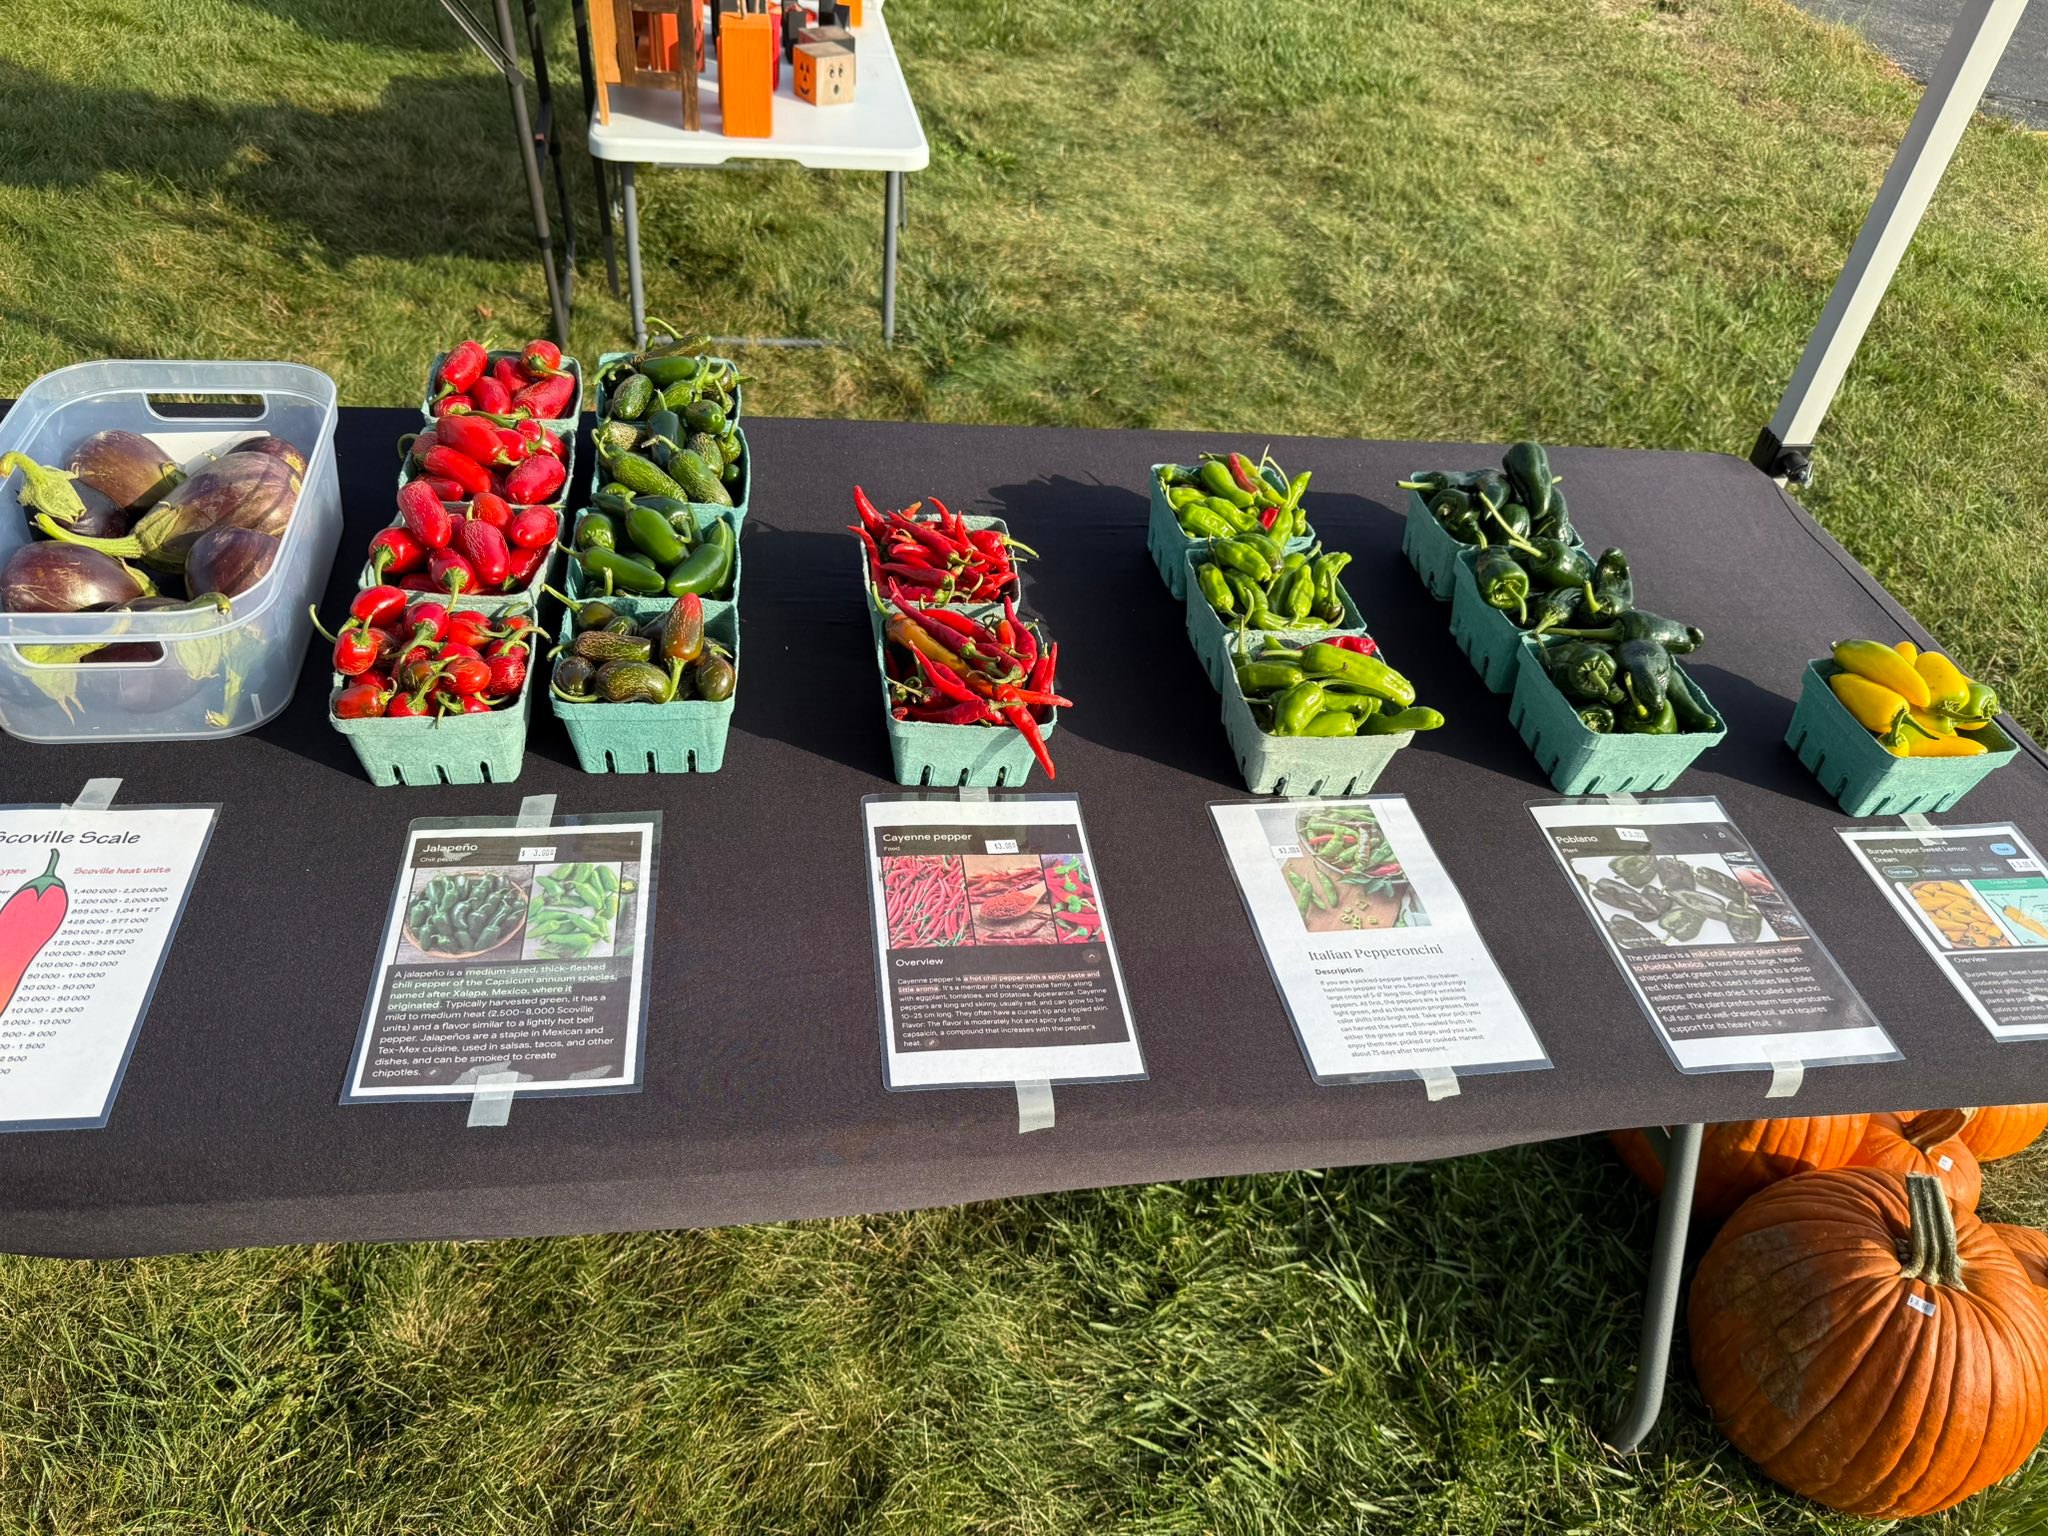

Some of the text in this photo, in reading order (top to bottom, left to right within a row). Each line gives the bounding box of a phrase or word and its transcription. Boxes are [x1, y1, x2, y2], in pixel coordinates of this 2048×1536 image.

[79, 831, 141, 844] Scale
[882, 833, 931, 842] Cayenne
[1555, 835, 1598, 843] Poblano
[422, 843, 478, 853] Jalapeño
[0, 868, 27, 876] ypes
[1308, 944, 1444, 960] Italian Pepperoncini
[895, 957, 944, 966] Overview
[403, 969, 444, 979] jalapeño
[541, 963, 605, 972] thick-fleshed
[1314, 966, 1363, 975] Description
[414, 981, 450, 989] pepper
[484, 976, 533, 986] Capsicum
[577, 973, 617, 982] species,
[426, 989, 450, 997] after
[452, 988, 489, 998] Xalapa,
[491, 986, 530, 995] Mexico,
[532, 985, 563, 993] where
[387, 1001, 442, 1011] originated.
[444, 999, 487, 1009] Typically
[489, 997, 537, 1005] harvested
[539, 997, 570, 1005] green,
[581, 994, 598, 1002] has
[408, 1012, 418, 1020] to
[420, 1011, 461, 1019] medium
[556, 1005, 593, 1013] Scoville
[382, 1023, 410, 1033] units)
[412, 1022, 431, 1030] and
[442, 1021, 470, 1029] flavor
[472, 1019, 503, 1027] similar
[526, 1017, 555, 1027] lightly
[557, 1016, 574, 1024] hot
[374, 1057, 410, 1066] dishes,
[412, 1056, 431, 1064] and
[454, 1054, 467, 1062] be
[469, 1052, 510, 1061] smoked
[524, 1050, 557, 1059] create
[371, 1067, 421, 1078] chipotles.
